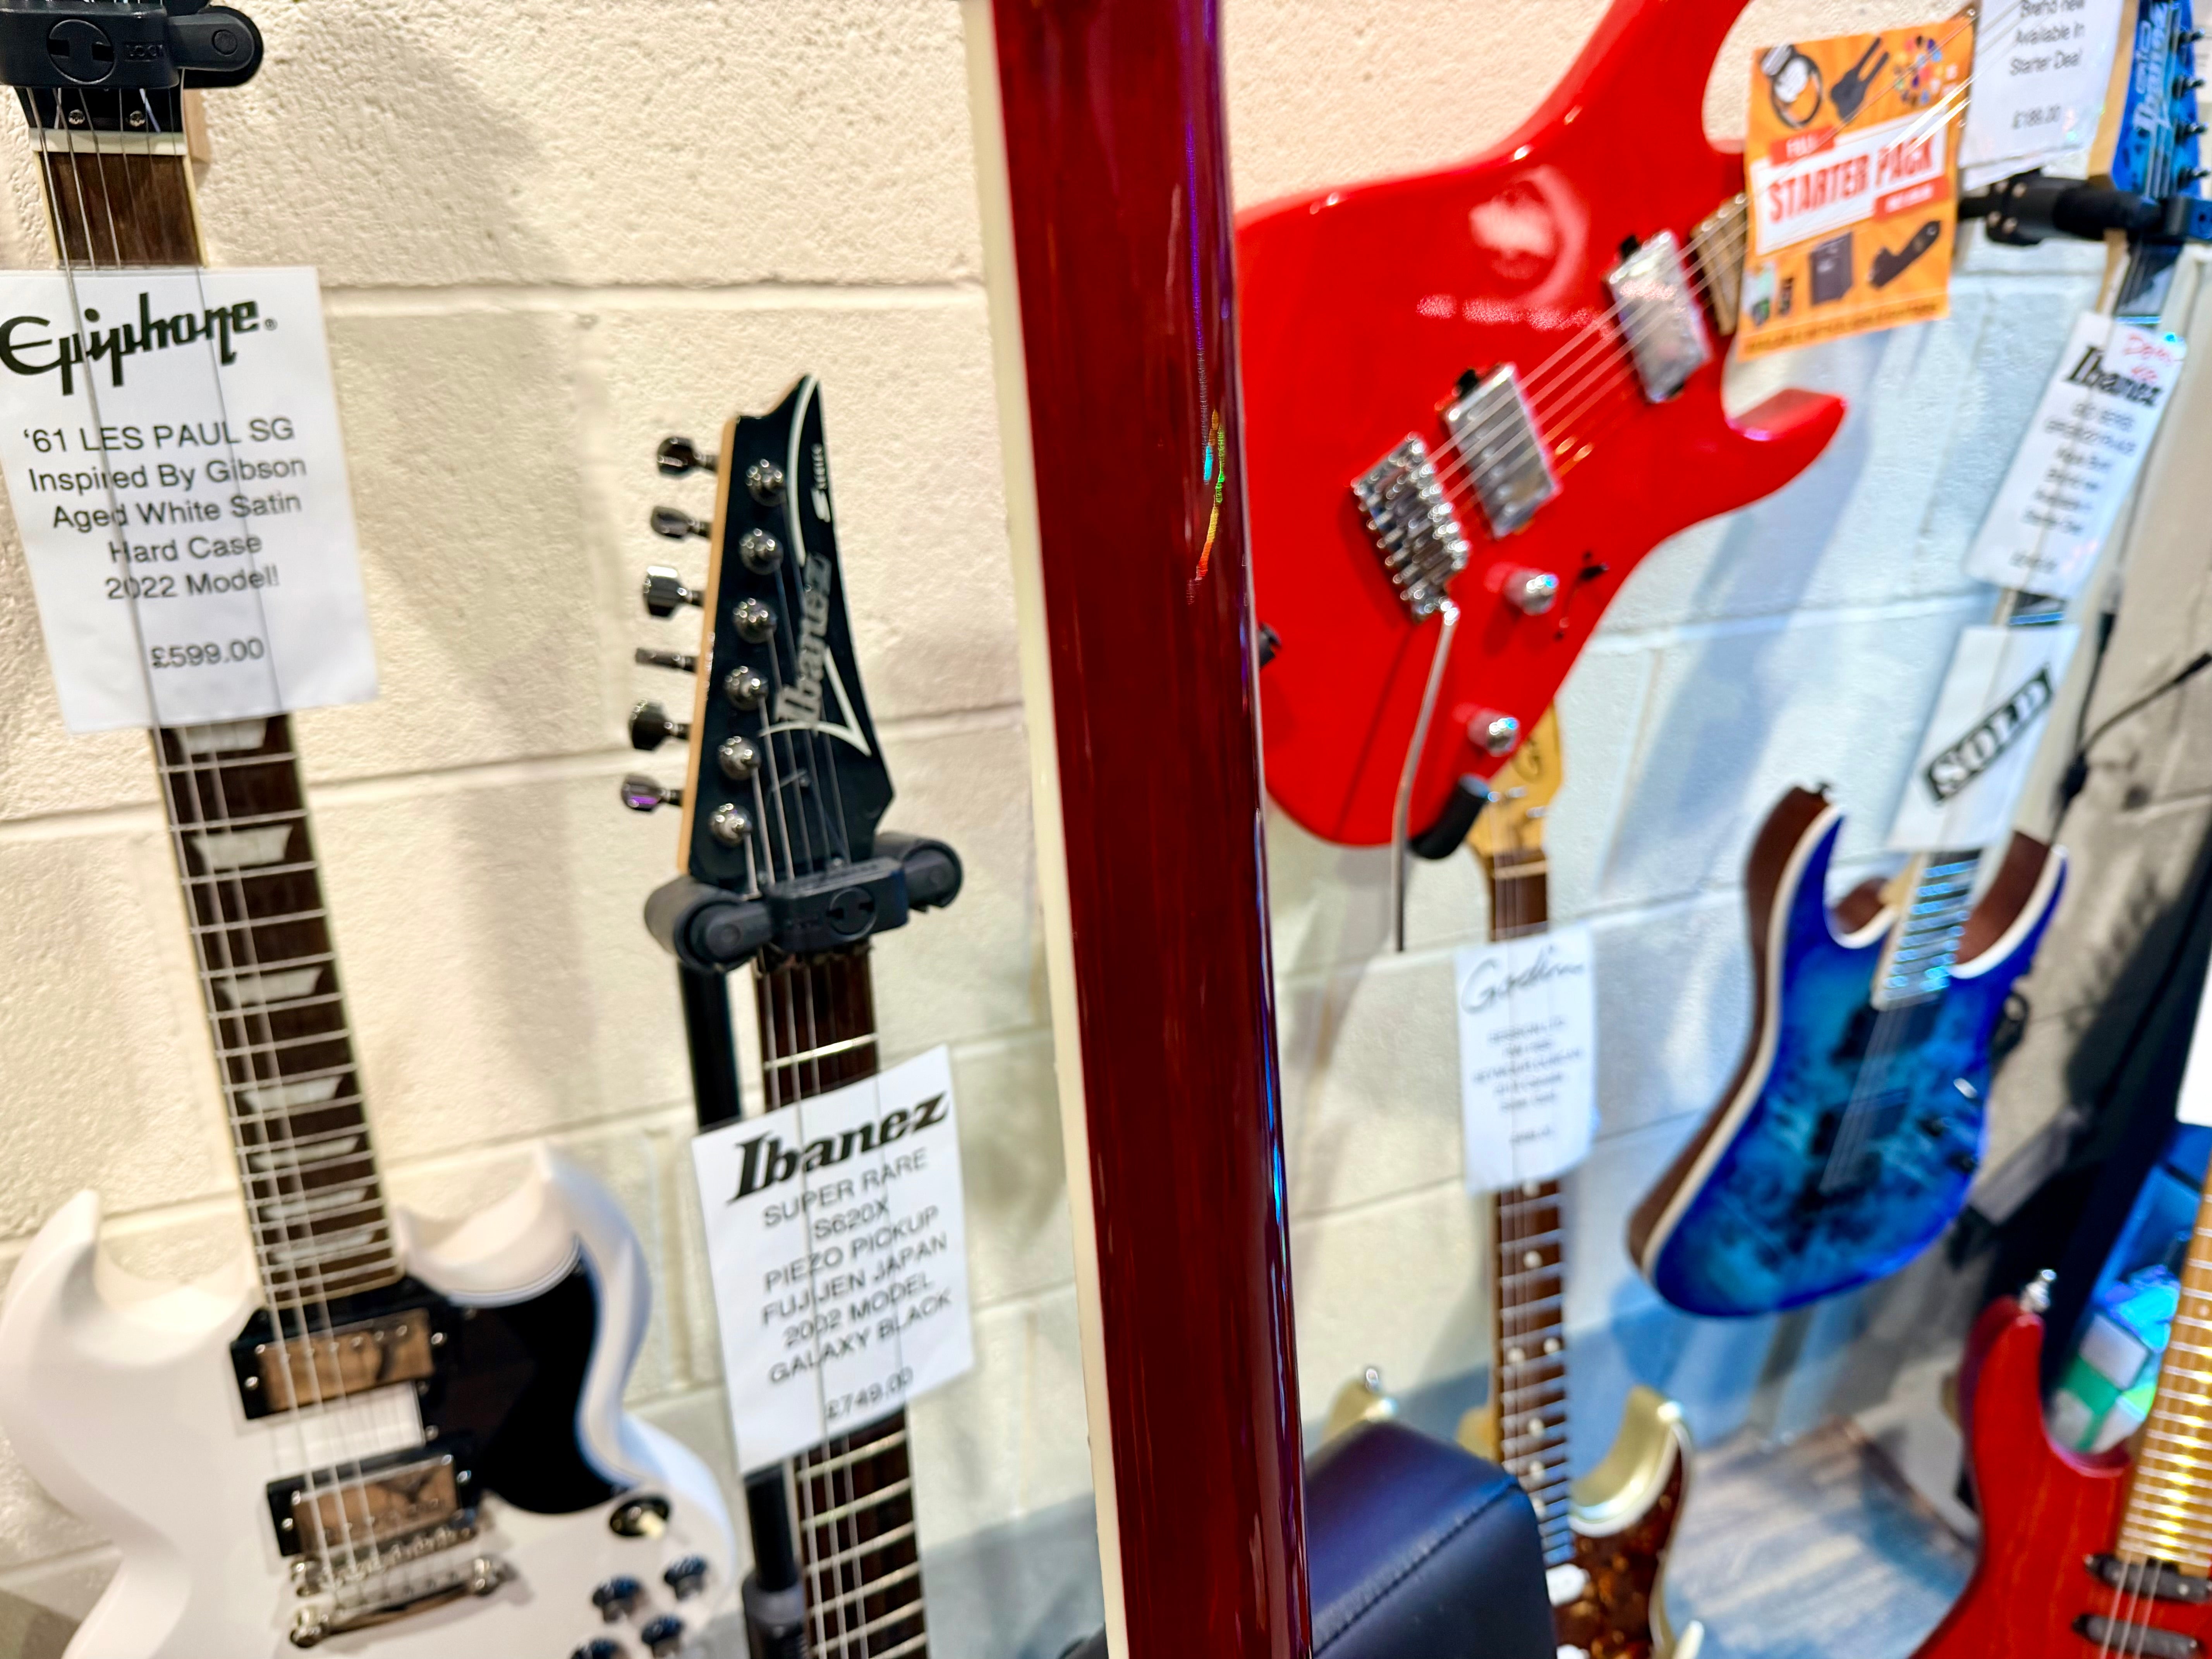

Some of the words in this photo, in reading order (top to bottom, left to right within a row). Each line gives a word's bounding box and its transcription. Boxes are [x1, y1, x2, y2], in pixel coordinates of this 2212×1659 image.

[1768, 155, 1869, 223] STARTER
[1875, 136, 1932, 187] PACK
[0, 292, 259, 395] Epiphone
[2064, 345, 2161, 406] Ibanez
[80, 426, 144, 451] LES
[154, 421, 241, 448] PAUL
[249, 416, 295, 441] SG
[29, 464, 148, 496] Inspired
[158, 464, 195, 491] By
[207, 458, 307, 483] Gibson
[53, 503, 128, 533] Aged
[136, 500, 220, 524] White
[230, 491, 302, 518] Satin
[108, 539, 178, 563] Hard
[189, 534, 262, 559] Case
[105, 575, 177, 599] 2022
[150, 637, 264, 668] £599.00
[774, 551, 831, 728] Ibanez
[1930, 676, 2049, 797] SOLD
[726, 1091, 950, 1206] Ibanez
[763, 1179, 854, 1228] SUPER
[861, 1146, 928, 1192] RARE
[815, 1195, 890, 1239] S620X
[764, 1246, 844, 1293] PIEZO
[852, 1205, 939, 1259] PICKUP
[874, 1231, 947, 1281] JAPAN
[768, 1326, 871, 1383] GALAXY
[878, 1288, 951, 1341] BLACK
[783, 1308, 842, 1348] 2002
[849, 1272, 933, 1321] MODEL
